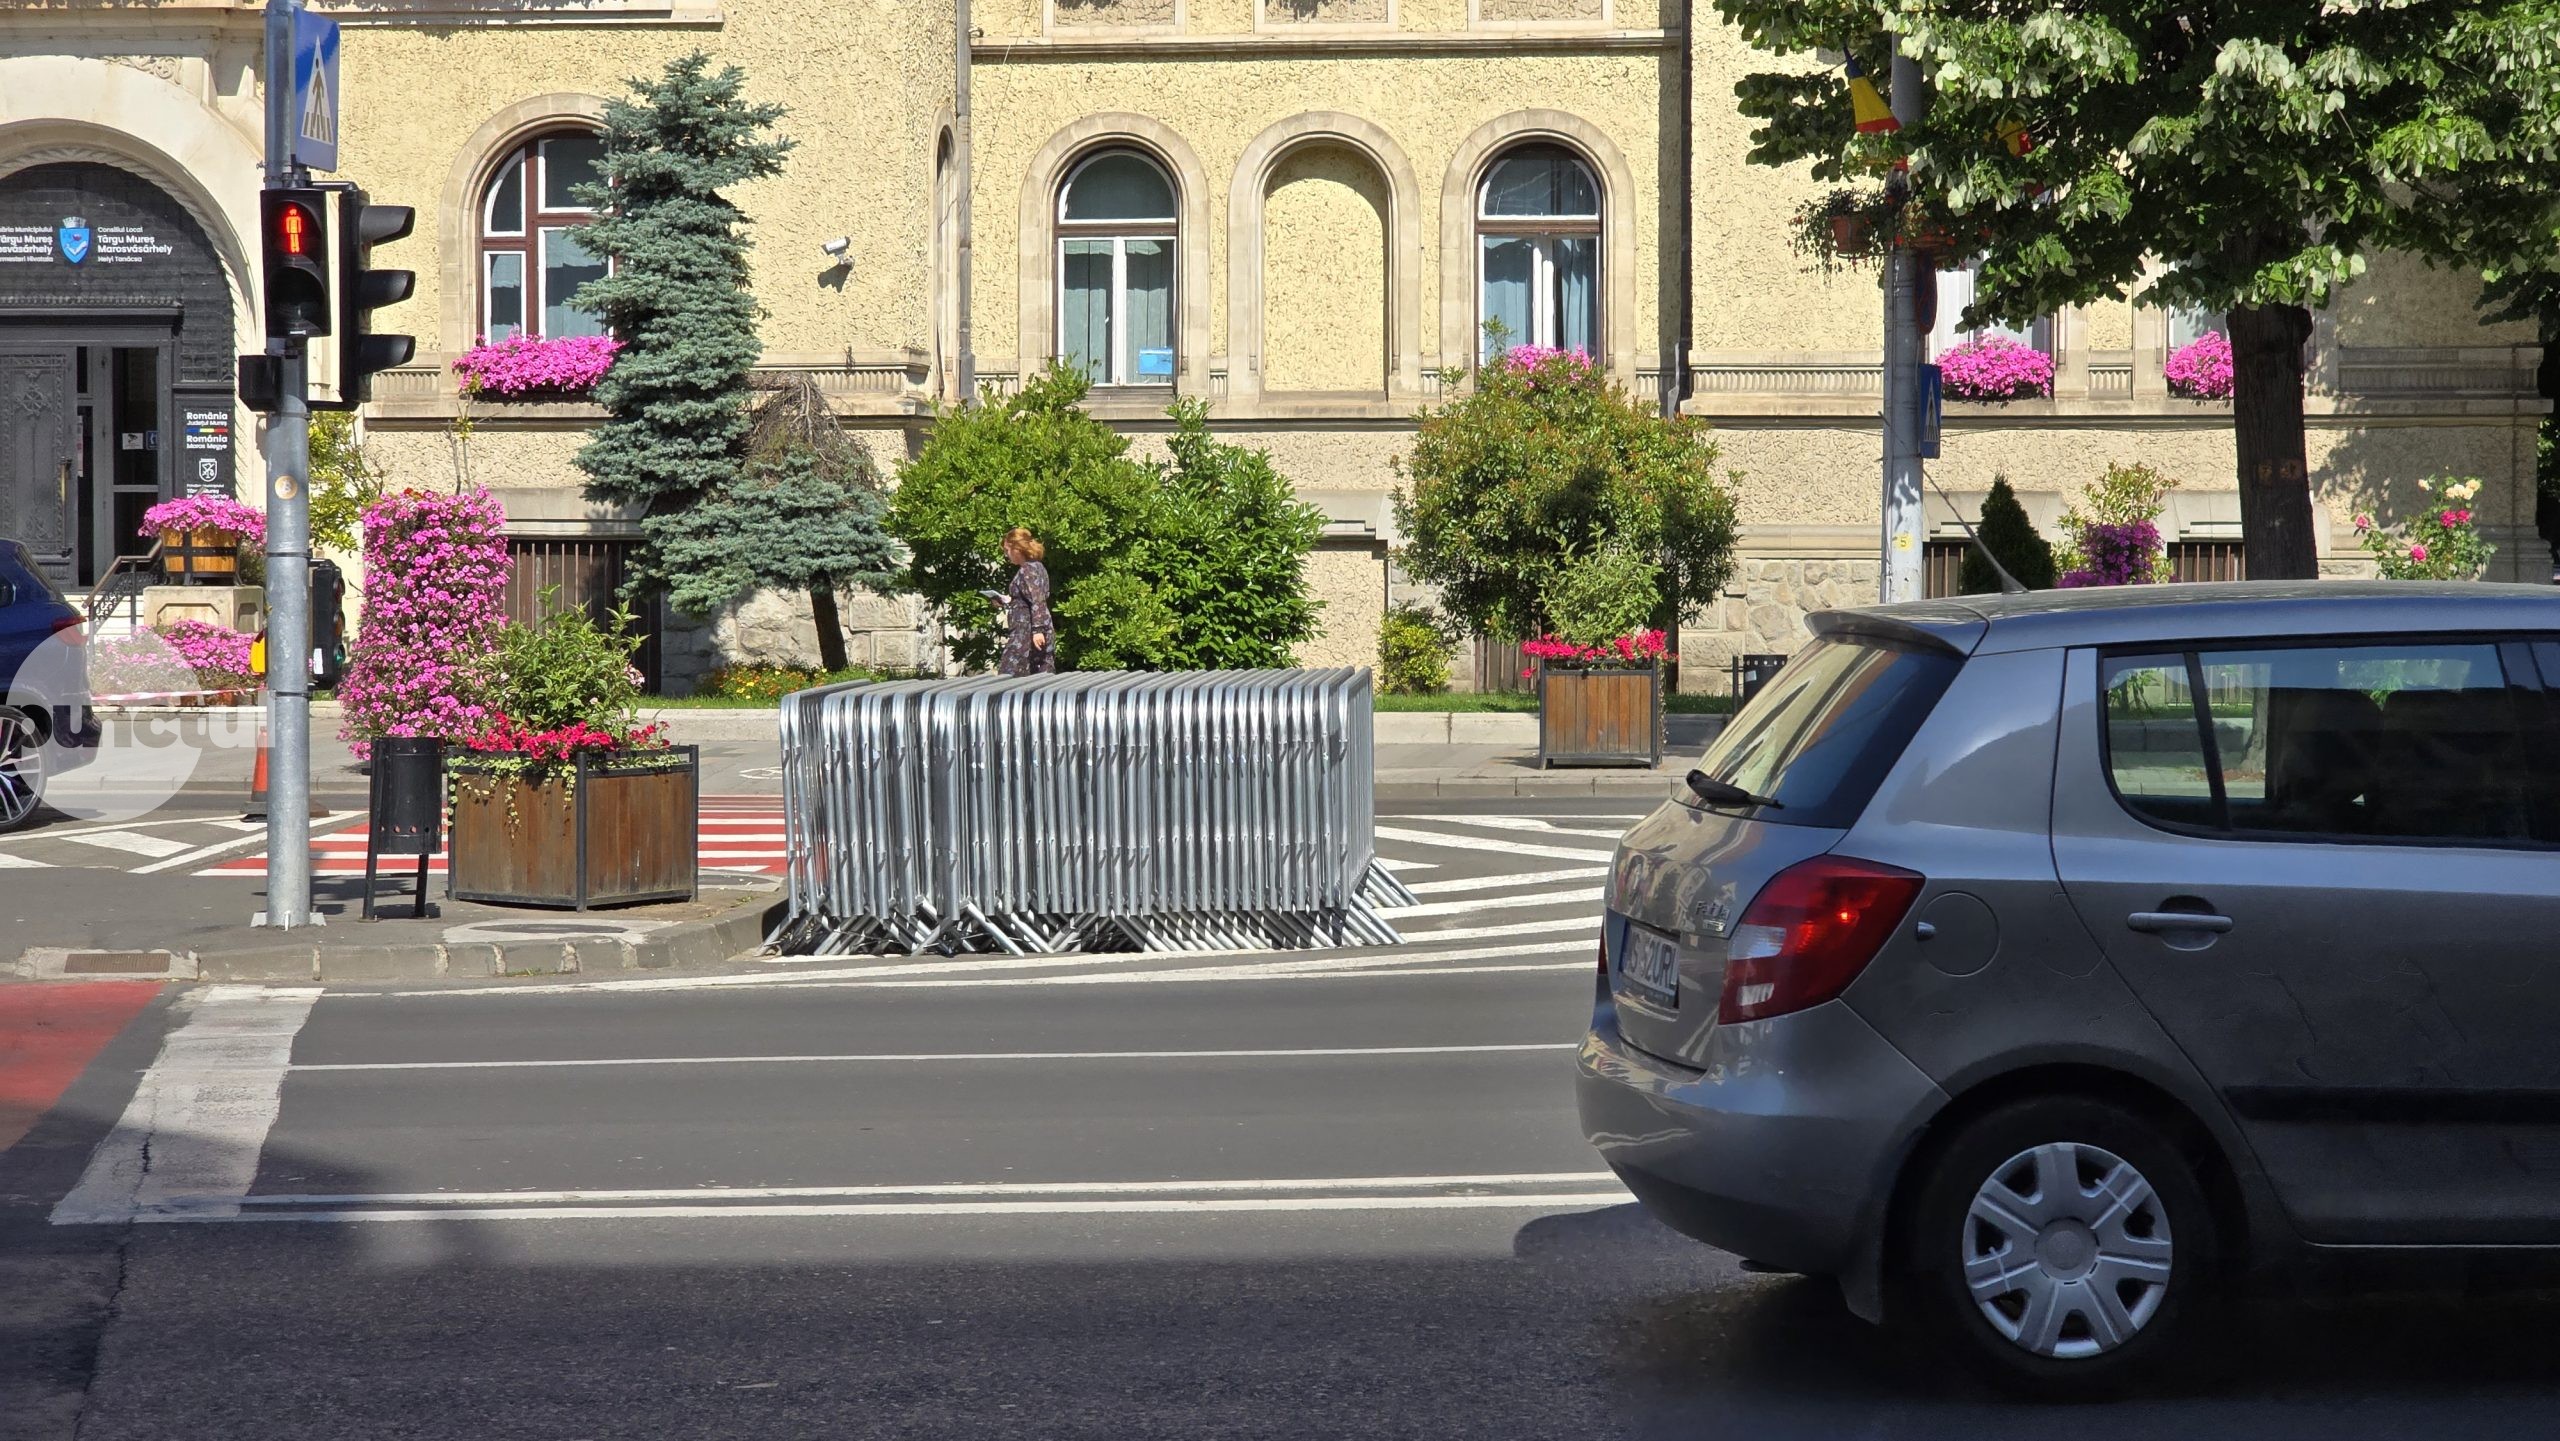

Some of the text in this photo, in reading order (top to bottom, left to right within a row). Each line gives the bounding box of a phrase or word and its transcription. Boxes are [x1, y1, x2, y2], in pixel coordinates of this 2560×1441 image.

[97, 235, 155, 246] Târgu Mureș
[97, 244, 173, 256] Marosvásárhely
[186, 411, 228, 420] România
